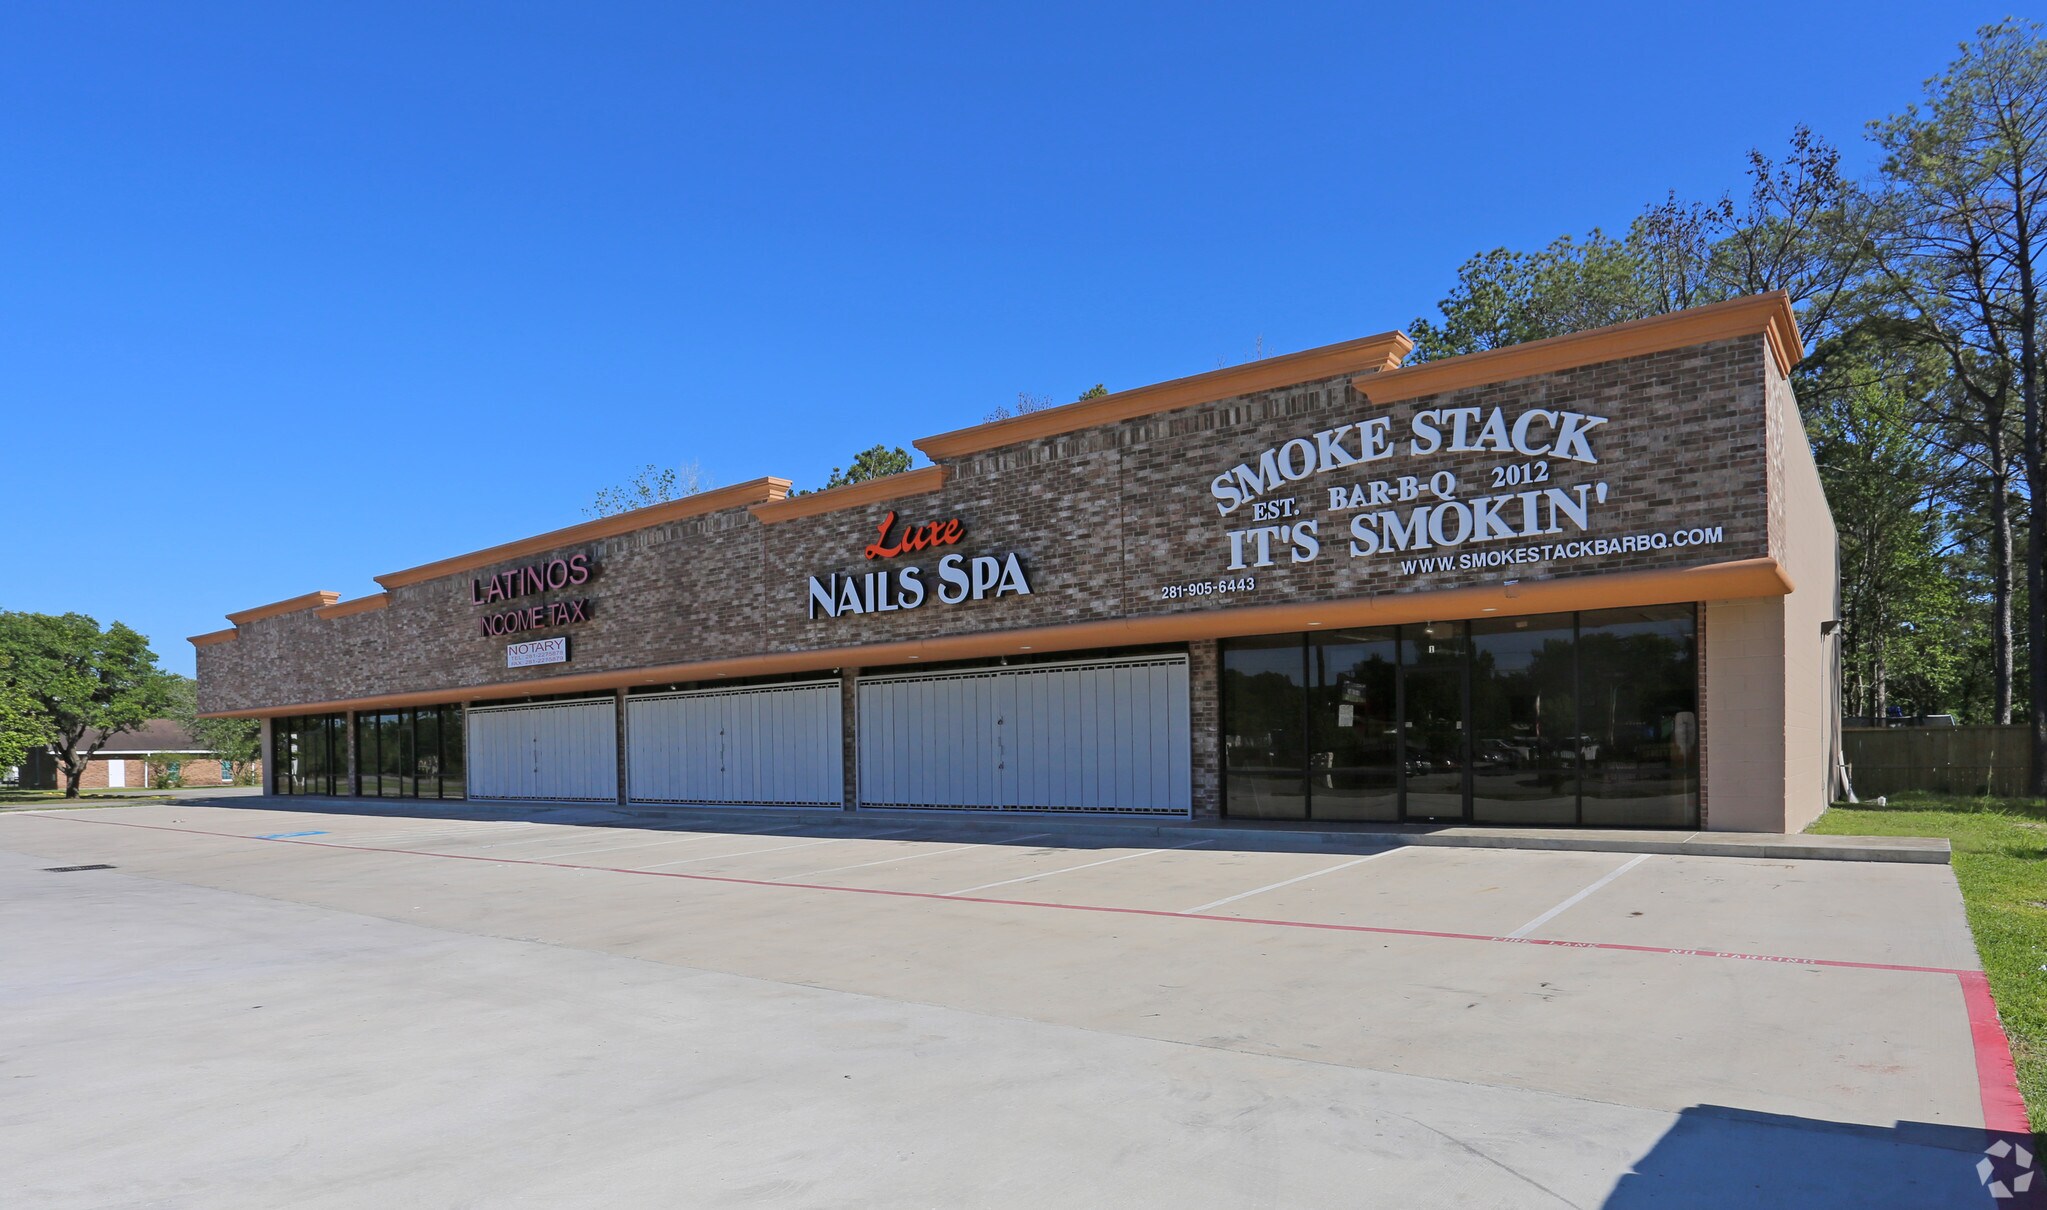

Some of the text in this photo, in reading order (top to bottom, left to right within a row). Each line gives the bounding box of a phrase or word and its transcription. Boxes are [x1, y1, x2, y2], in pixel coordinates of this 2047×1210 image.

[1210, 406, 1608, 517] SMOKE STACK
[1252, 460, 1549, 522] EST. BAR-B-Q 2012
[865, 510, 964, 559] Luxe
[1226, 482, 1609, 571] IT'S SMOKIN'
[471, 553, 588, 606] LATINOS
[809, 552, 1031, 619] NAILS SPA
[1161, 577, 1256, 599] 281-905-6443
[549, 598, 586, 625] TAX
[508, 639, 564, 655] NOTARY
